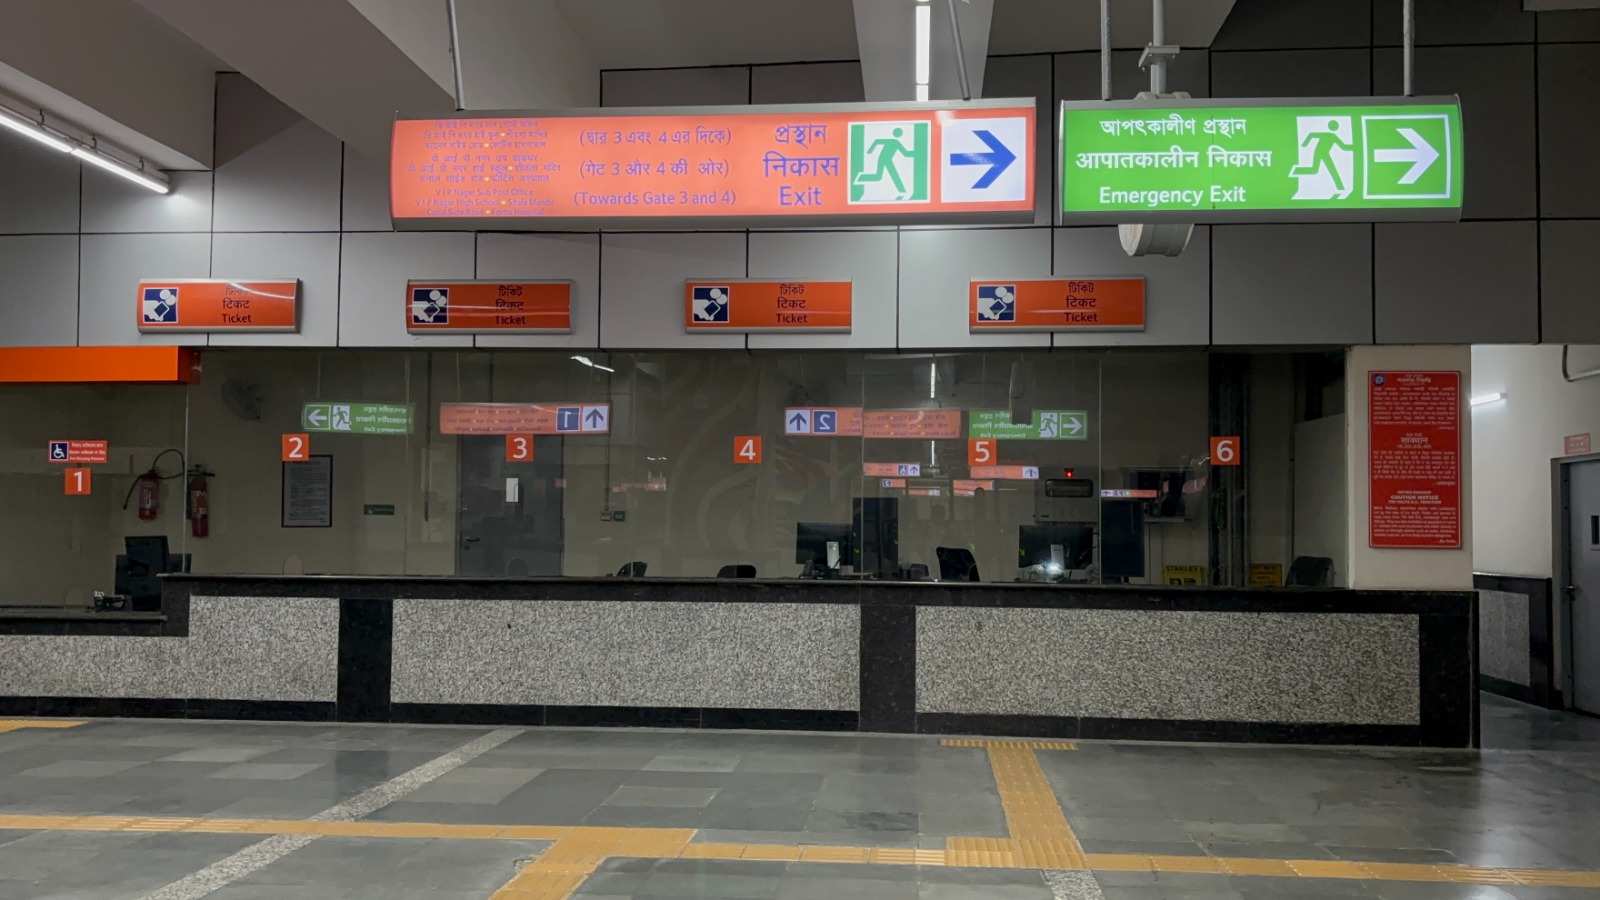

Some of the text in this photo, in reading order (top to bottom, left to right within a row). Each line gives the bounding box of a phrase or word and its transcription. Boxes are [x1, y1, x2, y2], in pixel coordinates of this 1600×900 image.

[579, 125, 731, 147] (দ্বার 3 এবং 4 এর দিকে)
[774, 122, 828, 150] প্রস্থান
[1203, 117, 1247, 139] প্রস্থান
[579, 157, 729, 179] (गेट 3 और 4 की ओर)
[762, 150, 840, 178] निकास
[1076, 145, 1273, 170] आपातकालीन निकास
[434, 198, 455, 207] Nagar
[456, 198, 473, 207] High
[475, 198, 500, 207] School
[454, 188, 475, 197] Nagar
[477, 188, 491, 197] Sub
[493, 188, 509, 197] Post
[511, 188, 534, 197] Office
[573, 189, 737, 207] (Towards Gate 3 and 4)
[780, 185, 823, 206] Exit
[1099, 184, 1247, 208] Emergency Exit
[779, 283, 805, 295] টিকিট
[1068, 281, 1094, 294] টিকিট
[222, 296, 250, 309] टिकट
[496, 298, 524, 311] टिकट
[777, 297, 806, 309] टिकट
[1066, 295, 1096, 308] टिकट
[222, 313, 252, 323] Ticket
[776, 312, 808, 323] Ticket
[1064, 312, 1098, 323] Ticket
[289, 436, 303, 458] 2
[513, 437, 528, 459] 3
[739, 439, 756, 461] 4
[975, 440, 990, 463] 5
[1216, 439, 1234, 462] 6
[73, 471, 83, 492] 1
